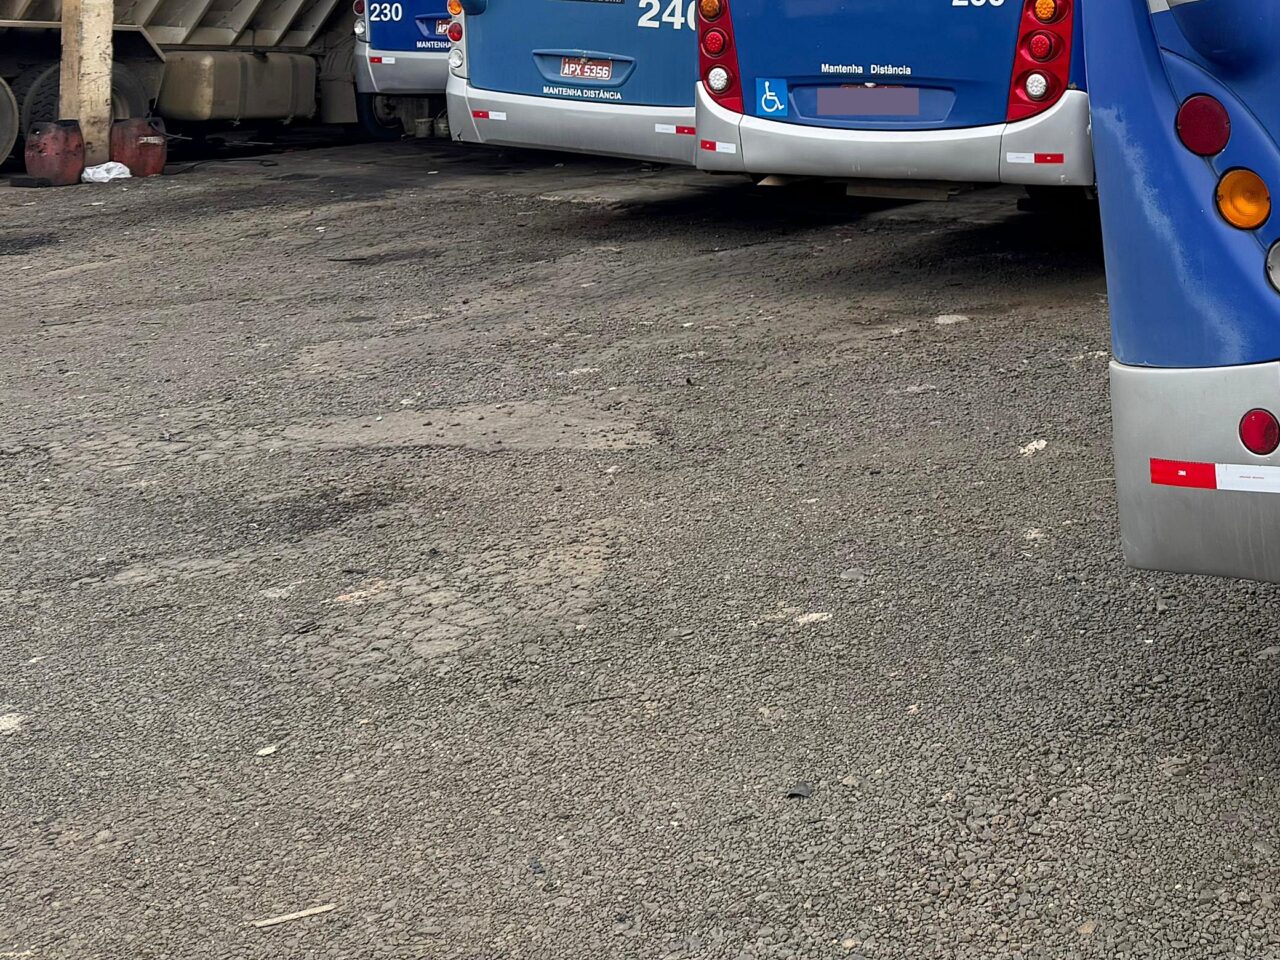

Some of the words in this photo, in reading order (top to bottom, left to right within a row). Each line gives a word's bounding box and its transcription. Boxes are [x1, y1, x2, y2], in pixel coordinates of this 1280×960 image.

[369, 2, 403, 22] 230
[562, 64, 582, 76] APX
[584, 66, 610, 79] 5356
[821, 63, 863, 74] Mantenha
[870, 64, 912, 75] Distância
[543, 85, 583, 97] MANTENHA
[583, 87, 622, 100] DISTÂNCIA
